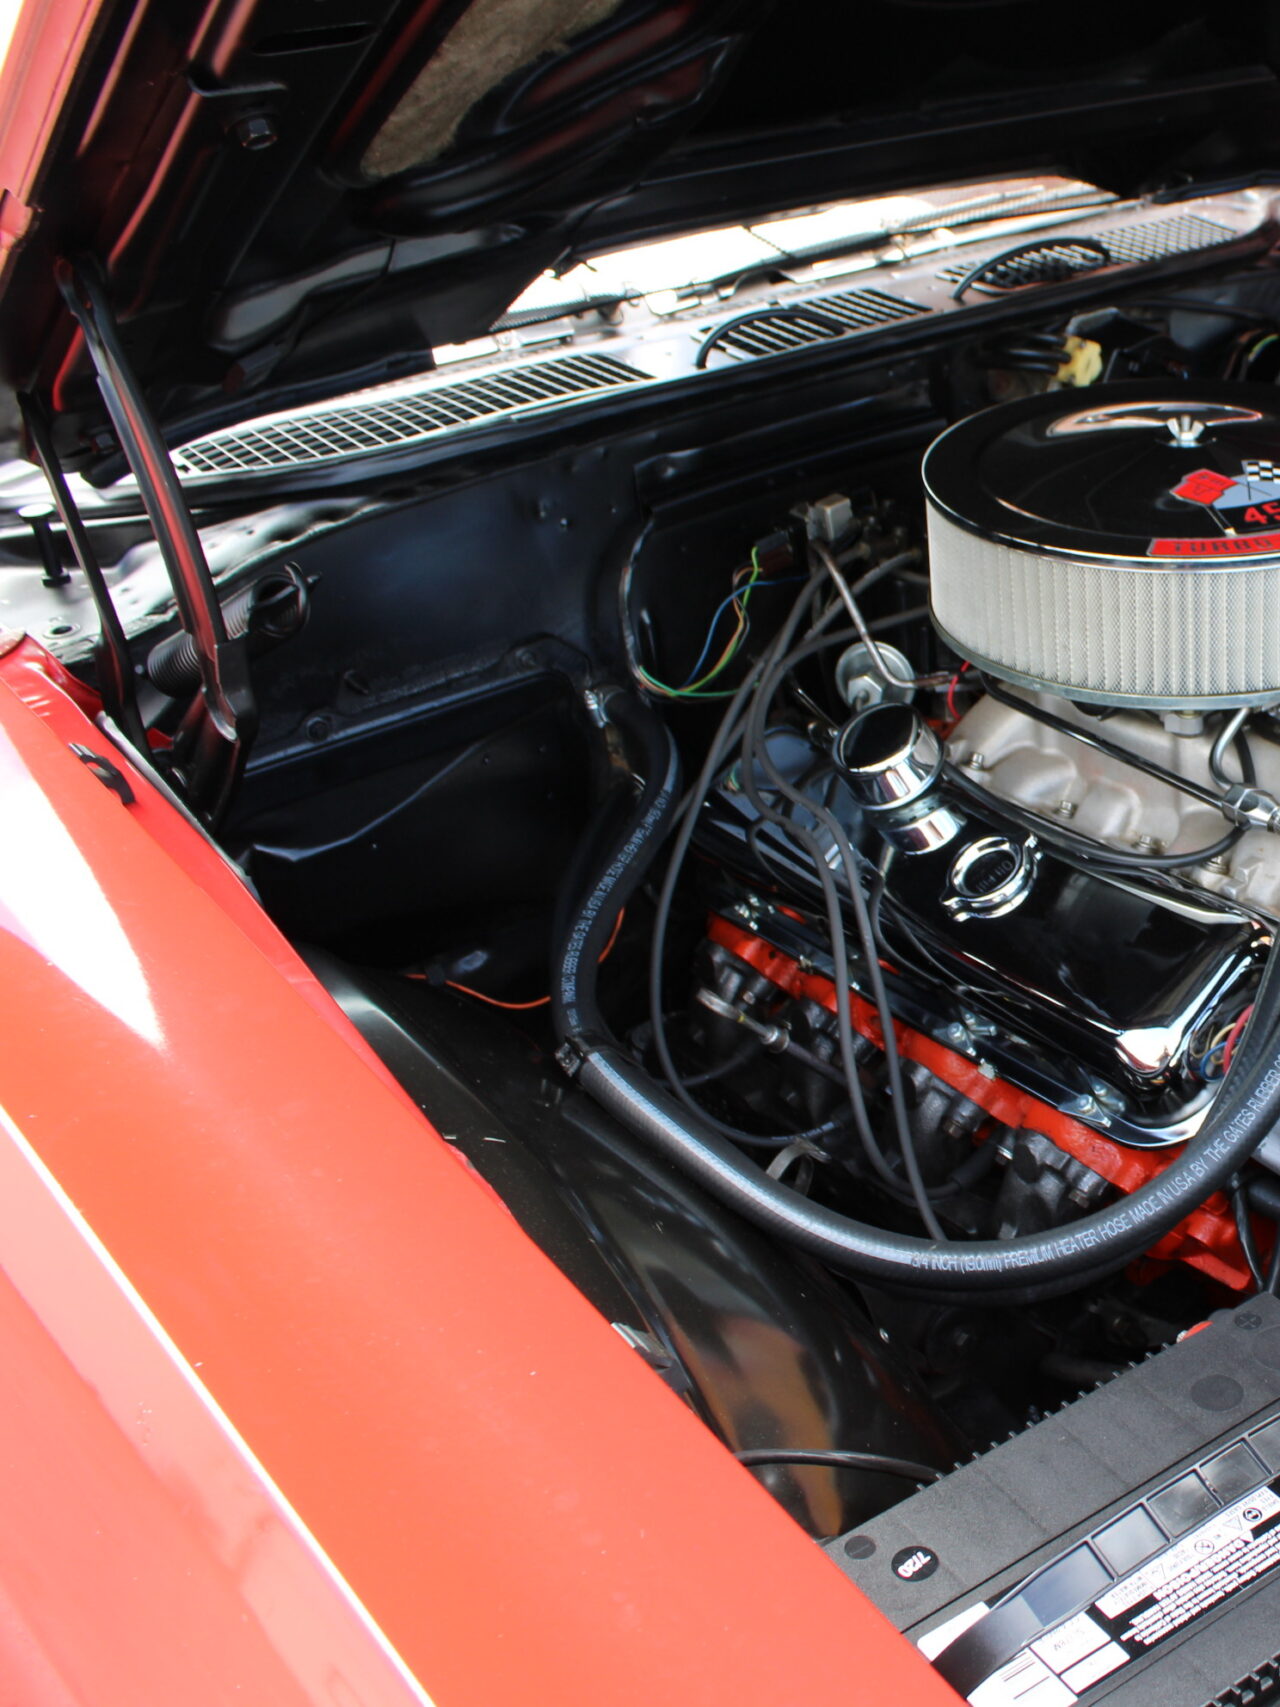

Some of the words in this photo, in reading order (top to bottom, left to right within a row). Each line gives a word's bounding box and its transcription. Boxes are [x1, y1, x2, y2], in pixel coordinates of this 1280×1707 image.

[1003, 1244, 1055, 1269] PREMIUM
[1054, 1228, 1100, 1259] HEATER
[1099, 1212, 1133, 1241] HOSE
[1128, 1196, 1163, 1226] MADE
[1157, 1186, 1173, 1207] IN
[1168, 1170, 1197, 1199] USA
[1189, 1156, 1210, 1179] BY
[1203, 1137, 1230, 1163] THE
[1223, 1108, 1257, 1144] GATES
[898, 1551, 931, 1578] 7/20
